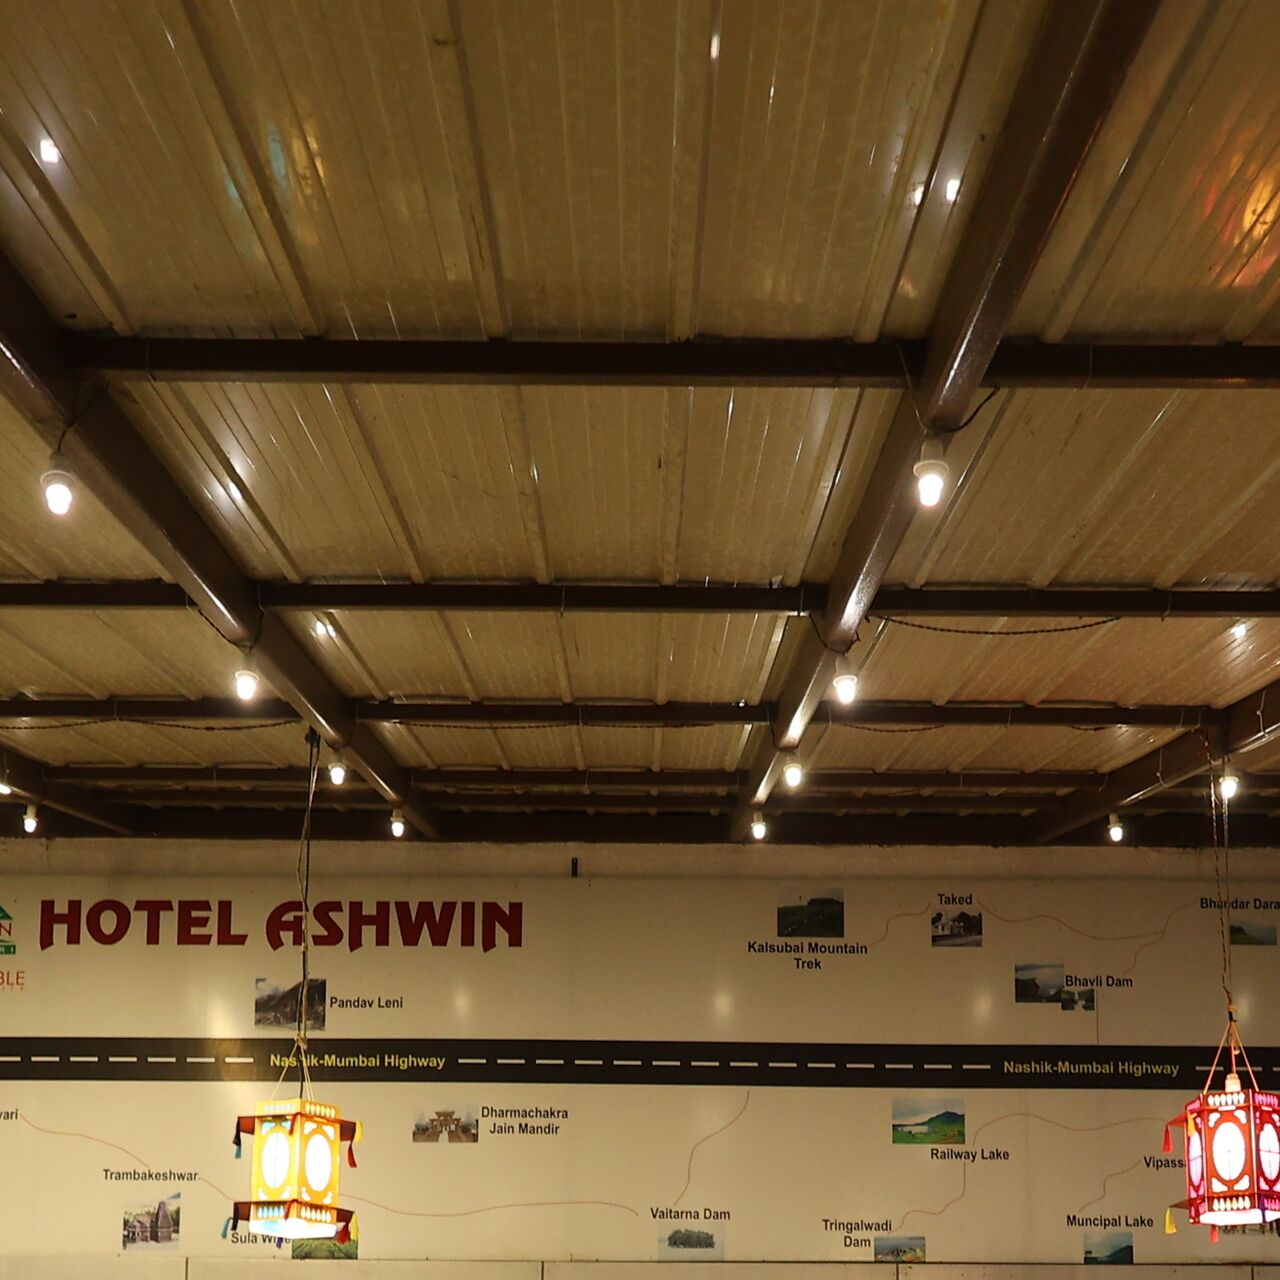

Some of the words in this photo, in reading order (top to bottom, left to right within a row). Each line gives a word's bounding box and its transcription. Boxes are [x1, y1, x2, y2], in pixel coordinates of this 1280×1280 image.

[938, 894, 972, 905] Taked
[1254, 898, 1280, 909] Dara
[40, 899, 248, 950] HOTEL
[266, 899, 523, 953] ASHWIN
[748, 942, 803, 953] Kalsubai
[808, 942, 867, 954] Mountain
[794, 958, 821, 969] Trek
[1066, 976, 1102, 988] Bhavli
[1106, 976, 1132, 988] Dam
[330, 997, 374, 1008] Pandav
[378, 997, 402, 1008] Leni
[270, 1054, 381, 1067] Nasik-Mumbai
[385, 1054, 446, 1070] Highway
[1004, 1061, 1113, 1073] Nashik-Mumbai
[1119, 1062, 1179, 1077] Highway
[482, 1107, 568, 1118] Dharmachakra
[490, 1123, 514, 1134] Jain
[519, 1123, 559, 1134] Mandir
[931, 1148, 977, 1162] Railway
[981, 1149, 1009, 1160] Lake
[103, 1169, 198, 1181] Trambakeshwar
[651, 1208, 699, 1219] Vaitarna
[704, 1208, 730, 1220] Dam
[822, 1219, 891, 1233] Tringalwadi
[1067, 1215, 1121, 1229] Muncipal
[1125, 1216, 1153, 1227] Lake
[231, 1233, 257, 1243] Sula
[262, 1235, 291, 1243] Wie
[844, 1236, 871, 1247] Dam
